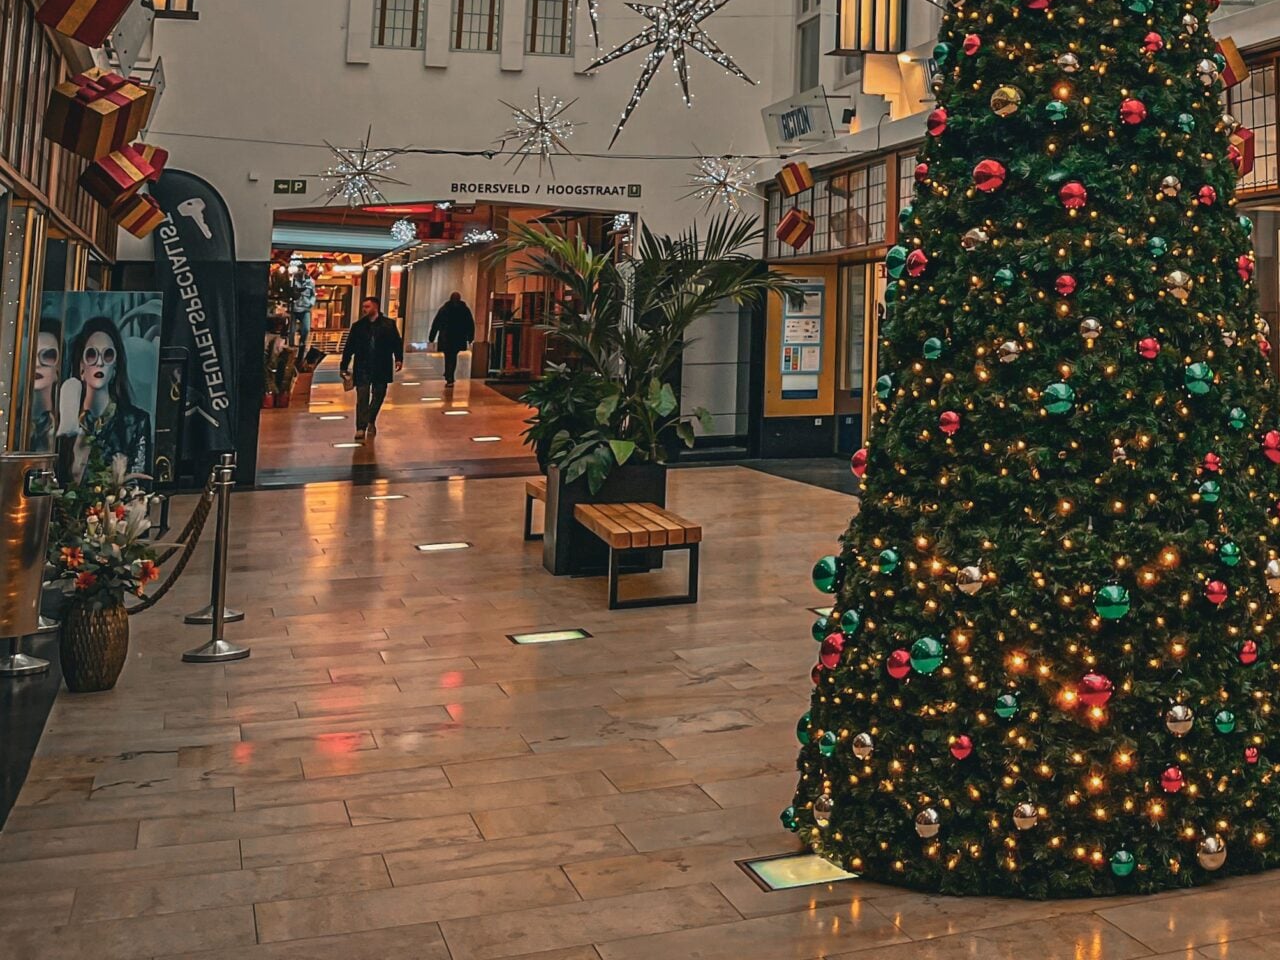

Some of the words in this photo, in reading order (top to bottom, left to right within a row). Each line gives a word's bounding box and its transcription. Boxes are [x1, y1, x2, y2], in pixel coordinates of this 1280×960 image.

[781, 105, 812, 141] ACTION
[294, 181, 304, 192] P
[450, 183, 531, 195] BROERSVELD
[546, 184, 626, 196] HOOGSTRAAT
